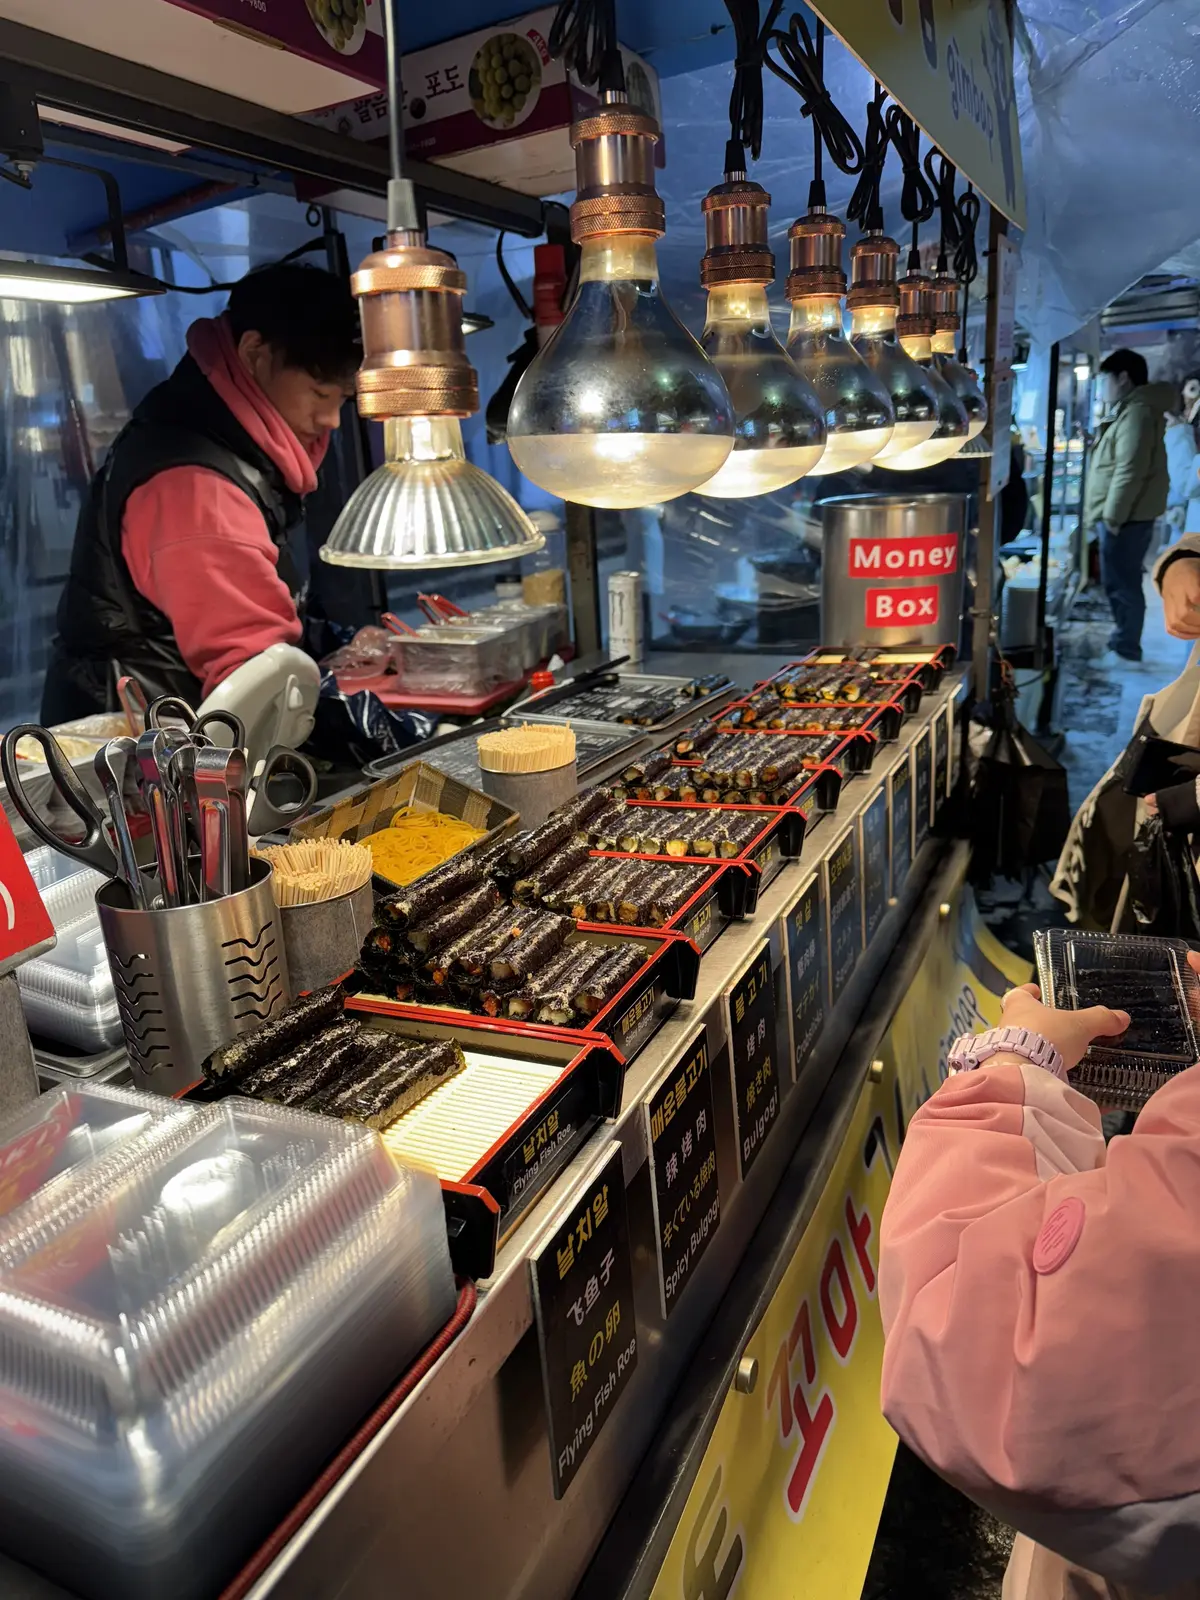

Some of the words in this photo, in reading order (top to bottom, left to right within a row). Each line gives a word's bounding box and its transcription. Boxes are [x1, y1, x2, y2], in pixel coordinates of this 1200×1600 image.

[425, 65, 464, 99] 포도
[854, 545, 956, 569] Money
[876, 595, 934, 618] Box
[693, 903, 711, 934] 불고기
[621, 986, 655, 1035] 매운불고기
[734, 962, 768, 1025] 불고기
[746, 1017, 767, 1062] 烤肉
[651, 1043, 708, 1143] 매운불고기
[746, 1056, 772, 1113] 焼き肉
[513, 1161, 539, 1195] Flying
[539, 1141, 556, 1164] Fish
[556, 1123, 571, 1143] Roe
[523, 1110, 559, 1164] 날치알
[665, 1107, 707, 1188] 辣烤肉
[743, 1085, 779, 1162] Bulgogi
[557, 1183, 609, 1281] 날치알
[663, 1149, 716, 1249] 辛くている焼肉
[665, 1247, 690, 1301] Spicy
[690, 1190, 720, 1257] Bulgogi
[567, 1247, 615, 1326] 飞鱼子
[569, 1299, 621, 1403] 魚の卵
[558, 1412, 594, 1480] Flying
[594, 1370, 617, 1414] Fish
[617, 1337, 637, 1373] Roe
